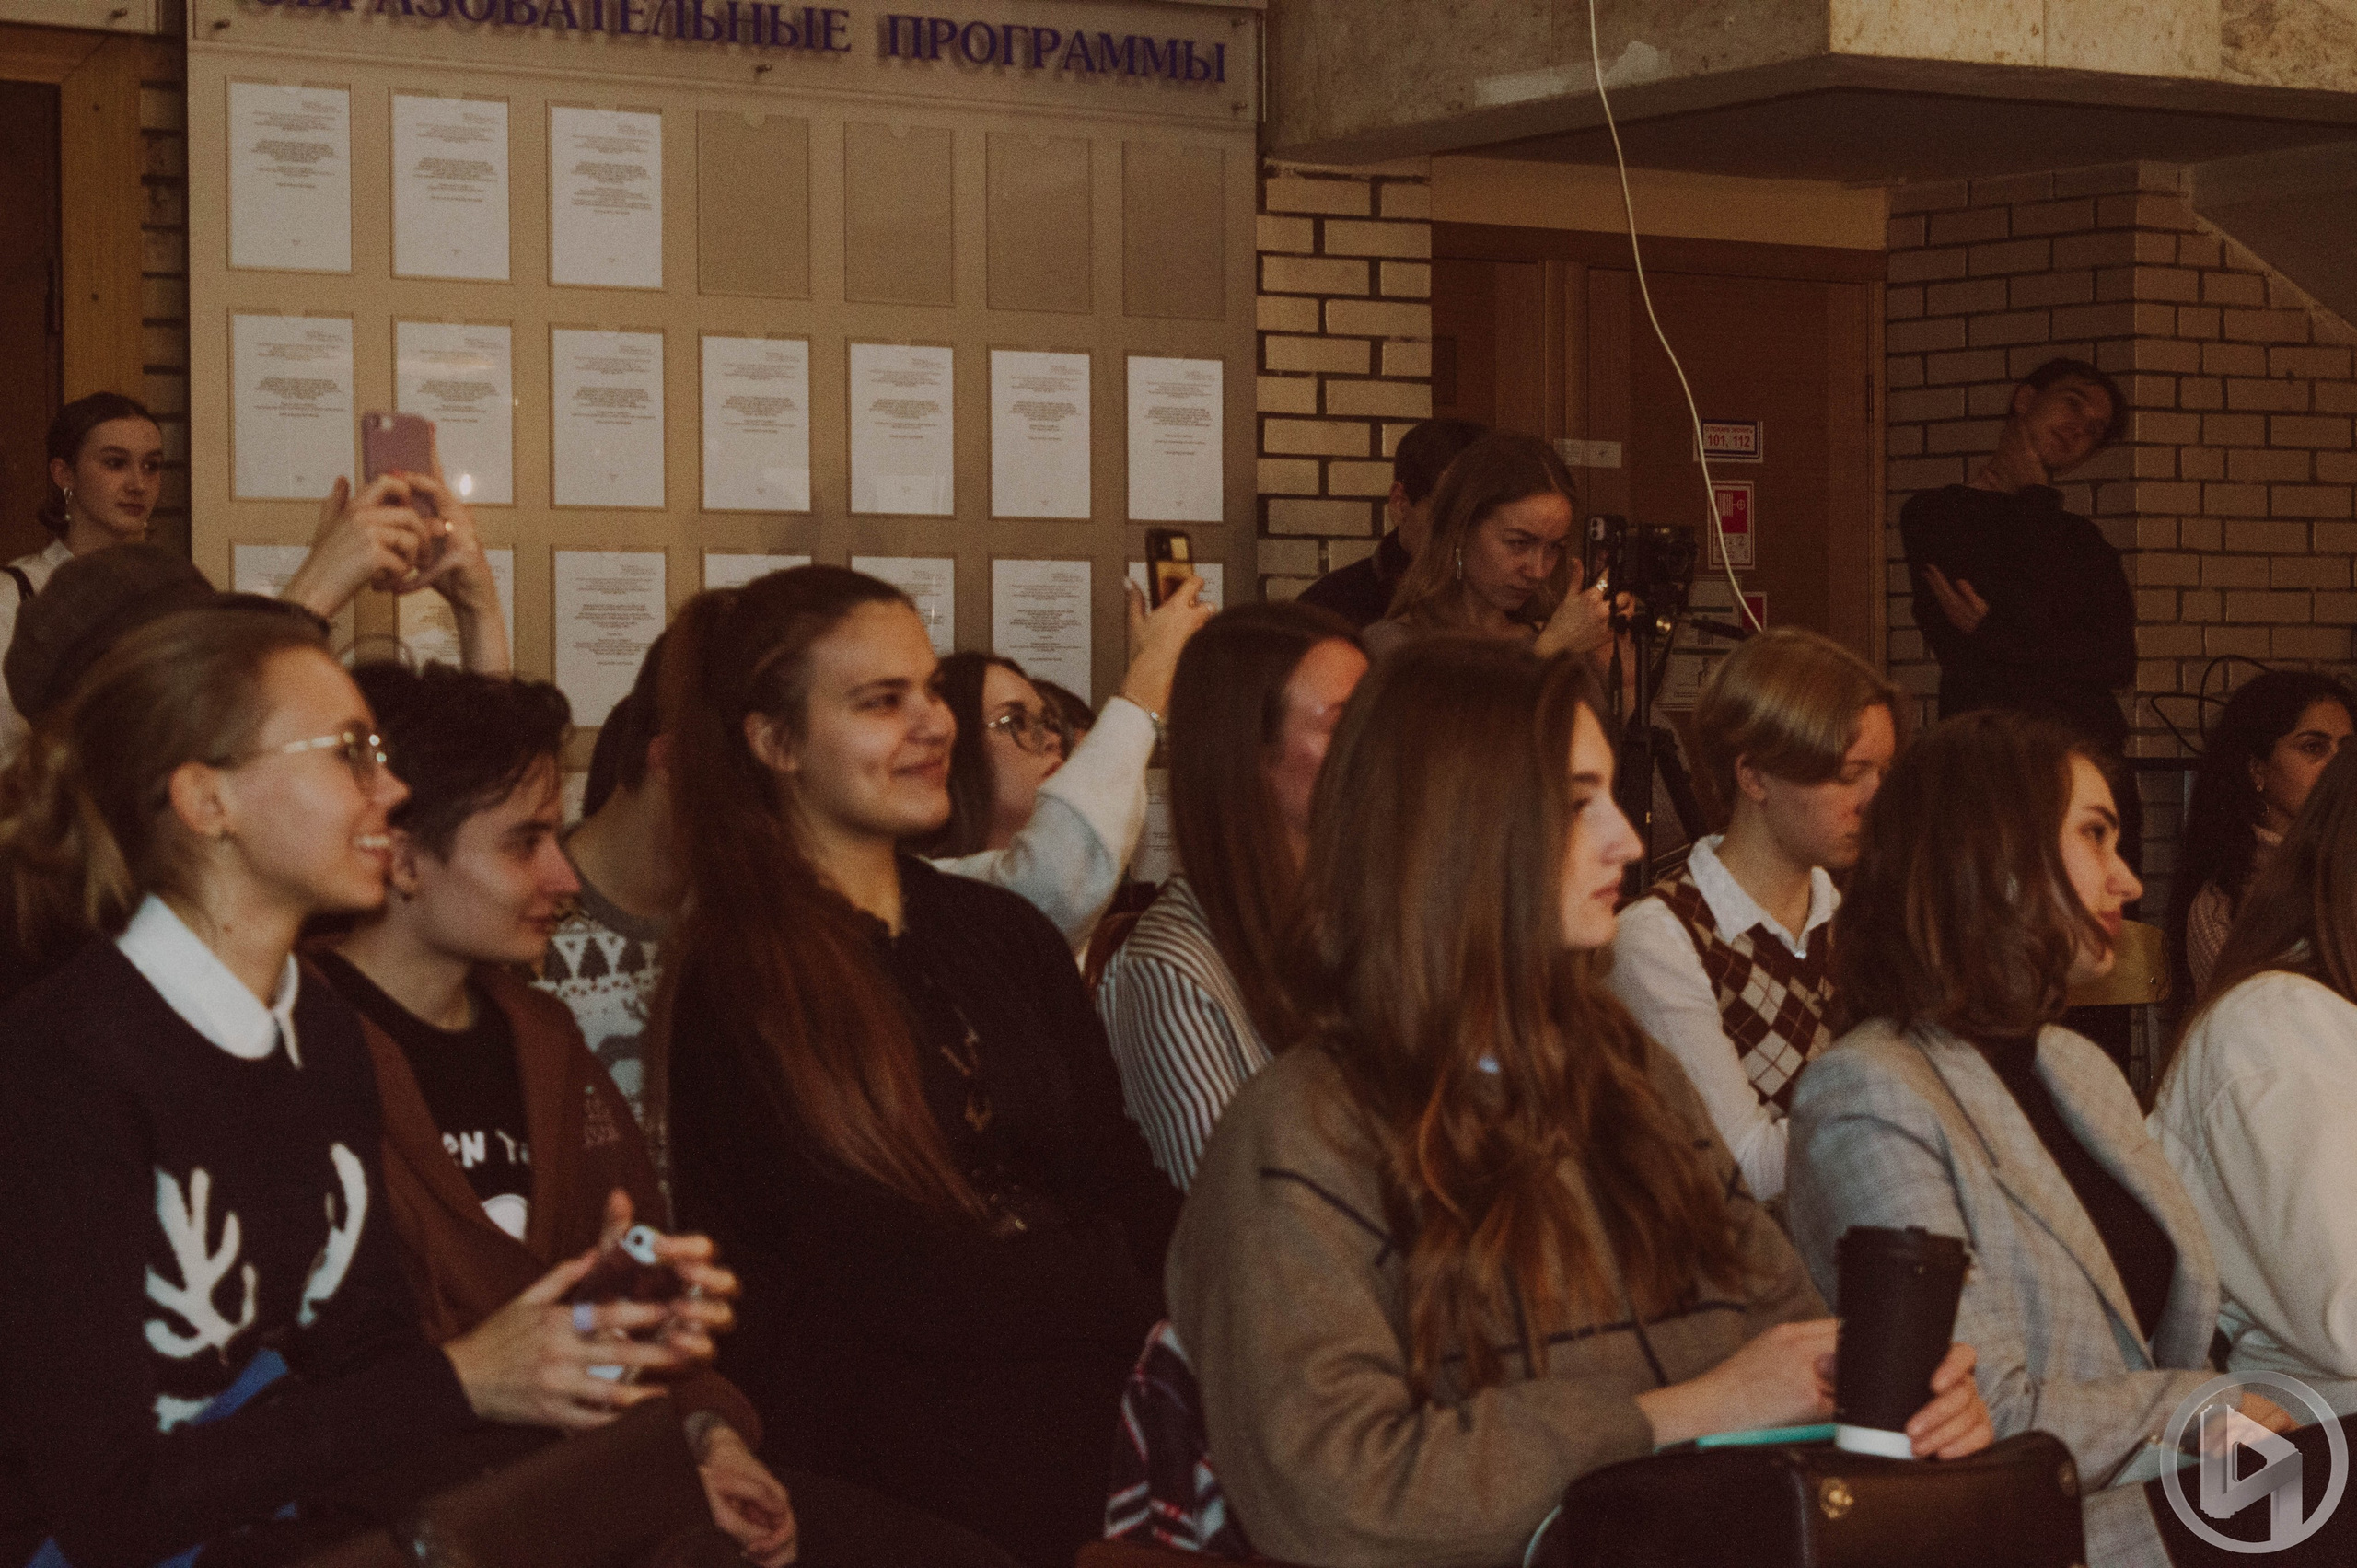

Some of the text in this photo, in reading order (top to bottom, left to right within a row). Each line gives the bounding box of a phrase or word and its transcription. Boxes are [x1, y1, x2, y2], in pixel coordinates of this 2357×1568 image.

[257, 0, 1225, 84] ВАТЕЛЬНЫЕ ПРОГРАММЫ
[1733, 435, 1750, 447] 112
